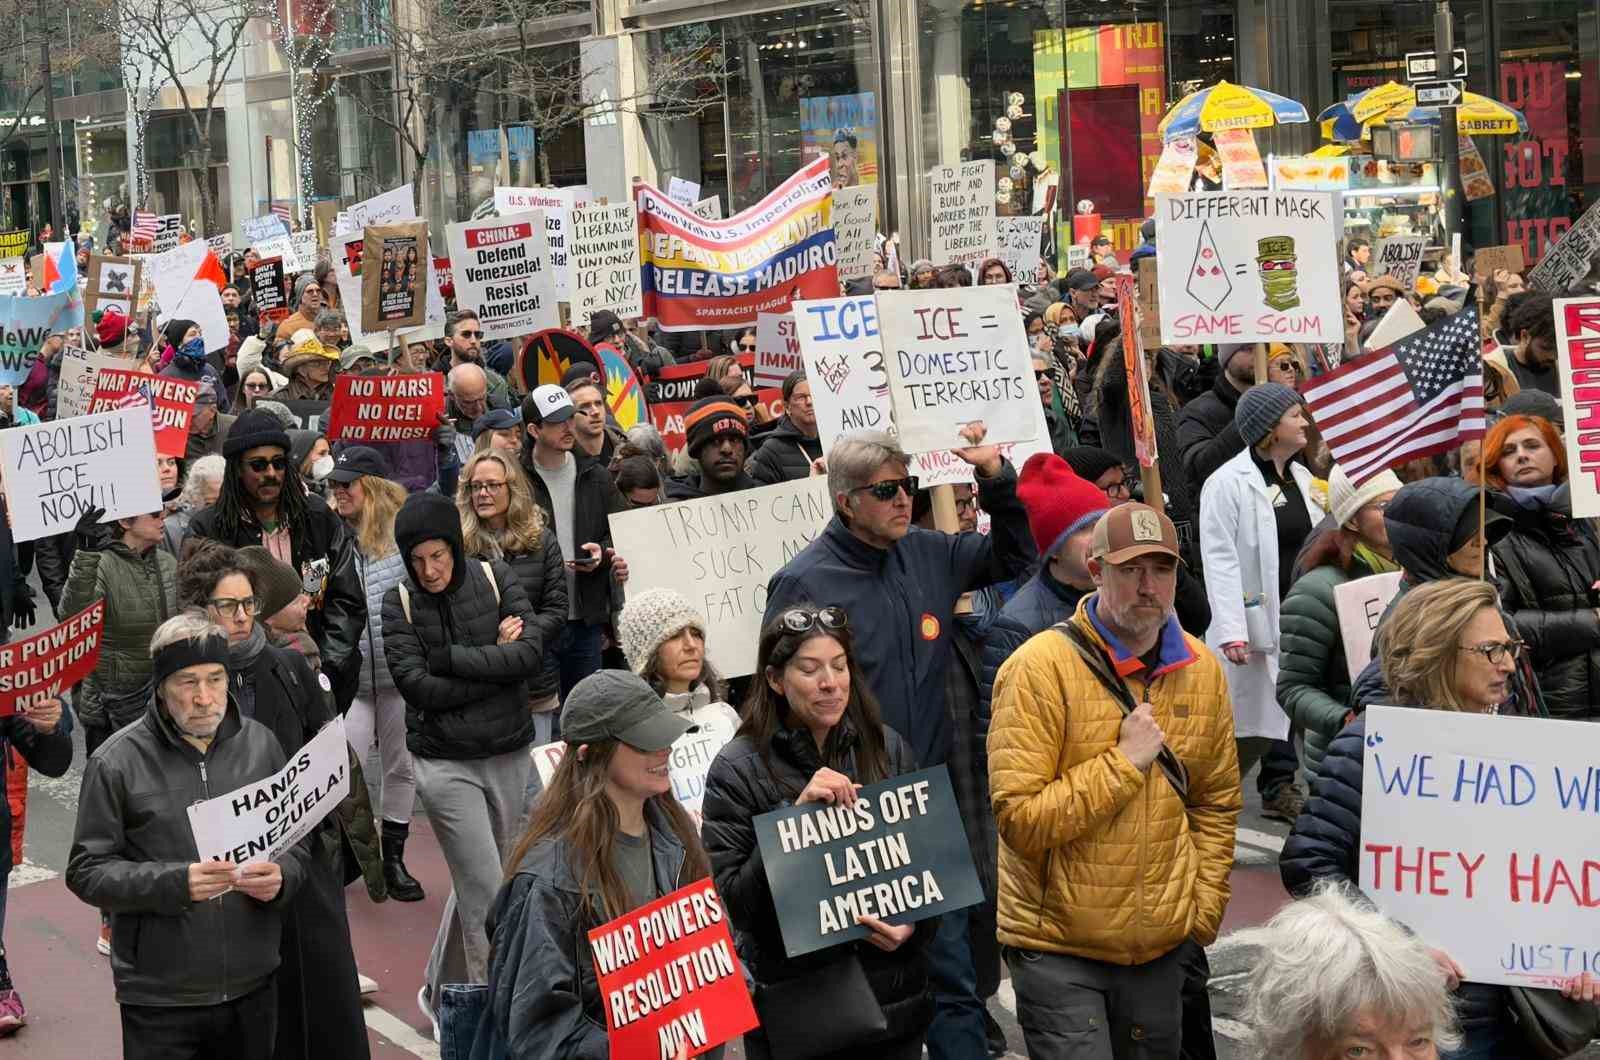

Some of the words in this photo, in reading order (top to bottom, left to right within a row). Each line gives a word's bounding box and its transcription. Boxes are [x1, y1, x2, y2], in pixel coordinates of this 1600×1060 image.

[1420, 90, 1432, 99] ONE
[1207, 114, 1270, 129] SABRETT
[1459, 119, 1512, 131] SABRETT
[942, 168, 954, 179] TO
[961, 164, 985, 177] FIGHT
[932, 181, 961, 194] TRUMP
[968, 179, 983, 191] AND
[508, 195, 526, 206] U.S.
[528, 196, 563, 208] Workers:
[645, 196, 679, 225] Down
[680, 216, 709, 239] With
[711, 227, 743, 241] U.S.
[744, 173, 832, 231] Imperialism
[940, 195, 965, 209] BUILD
[970, 193, 977, 204] A
[1169, 195, 1268, 221] DIFFERENT
[1275, 196, 1326, 220] MASK
[572, 210, 609, 224] DITCH
[615, 207, 629, 219] THE
[932, 208, 967, 225] WORKERS
[476, 227, 520, 246] CHINA:
[547, 234, 564, 248] nd
[575, 218, 634, 240] LIBERALS!
[939, 223, 965, 238] DUMP
[969, 220, 983, 233] THE
[477, 243, 526, 265] Defend
[570, 240, 619, 257] UNCHAIN
[944, 233, 987, 251] LIBERALS!
[1264, 240, 1289, 252] ICE
[1380, 243, 1422, 263] ABOLISH
[466, 257, 541, 283] Venezuela!
[578, 251, 634, 269] UNIONS!
[653, 267, 750, 297] RELEASE
[755, 240, 836, 292] MADURO
[577, 268, 603, 289] ICE
[610, 268, 635, 284] OUT
[485, 282, 529, 301] Resist
[583, 295, 597, 307] OF
[605, 283, 637, 303] NYC!
[479, 295, 540, 319] America!
[696, 305, 754, 317] SPARTACIST
[756, 296, 787, 313] LEAGUE
[806, 300, 880, 341] ICE
[913, 307, 969, 341] ICE
[1173, 313, 1245, 338] SAME
[1256, 313, 1322, 337] SCUM
[65, 346, 88, 360] ICE
[760, 351, 805, 371] IMMI
[897, 350, 1009, 379] DOMESTIC
[97, 372, 126, 392] WAR
[350, 379, 375, 397] NO
[381, 378, 433, 398] WARS!
[903, 376, 1025, 410] TERRORISTS
[93, 397, 188, 429] RESION
[358, 404, 383, 419] NO
[388, 404, 423, 420] ICE!
[841, 405, 881, 431] AND
[18, 417, 124, 471] ABOLISH
[341, 425, 368, 440] NO
[370, 426, 432, 440] KINGS!
[38, 463, 91, 498] ICE
[656, 498, 759, 548] TRUMP
[771, 487, 825, 522] CAN
[691, 543, 764, 581] SUCK
[704, 585, 743, 624] FAT
[22, 605, 103, 662] POWERS
[16, 679, 62, 712] NOW
[669, 739, 712, 771] GHT
[231, 752, 311, 817] HANDS
[673, 773, 706, 801] LU
[1452, 759, 1536, 806] HAD
[212, 765, 344, 865] VENEZUELA!
[265, 784, 301, 824] OFF
[776, 797, 875, 853] HANDS
[879, 780, 929, 824] OFF
[823, 832, 912, 886] LATIN
[1365, 843, 1485, 899] THEY
[1509, 852, 1600, 908] HAD
[818, 870, 944, 936] AMERICA
[591, 923, 640, 976] WAR
[637, 887, 723, 956] POWERS
[608, 938, 736, 1029] RESOLUTION
[657, 1008, 708, 1060] NOW
